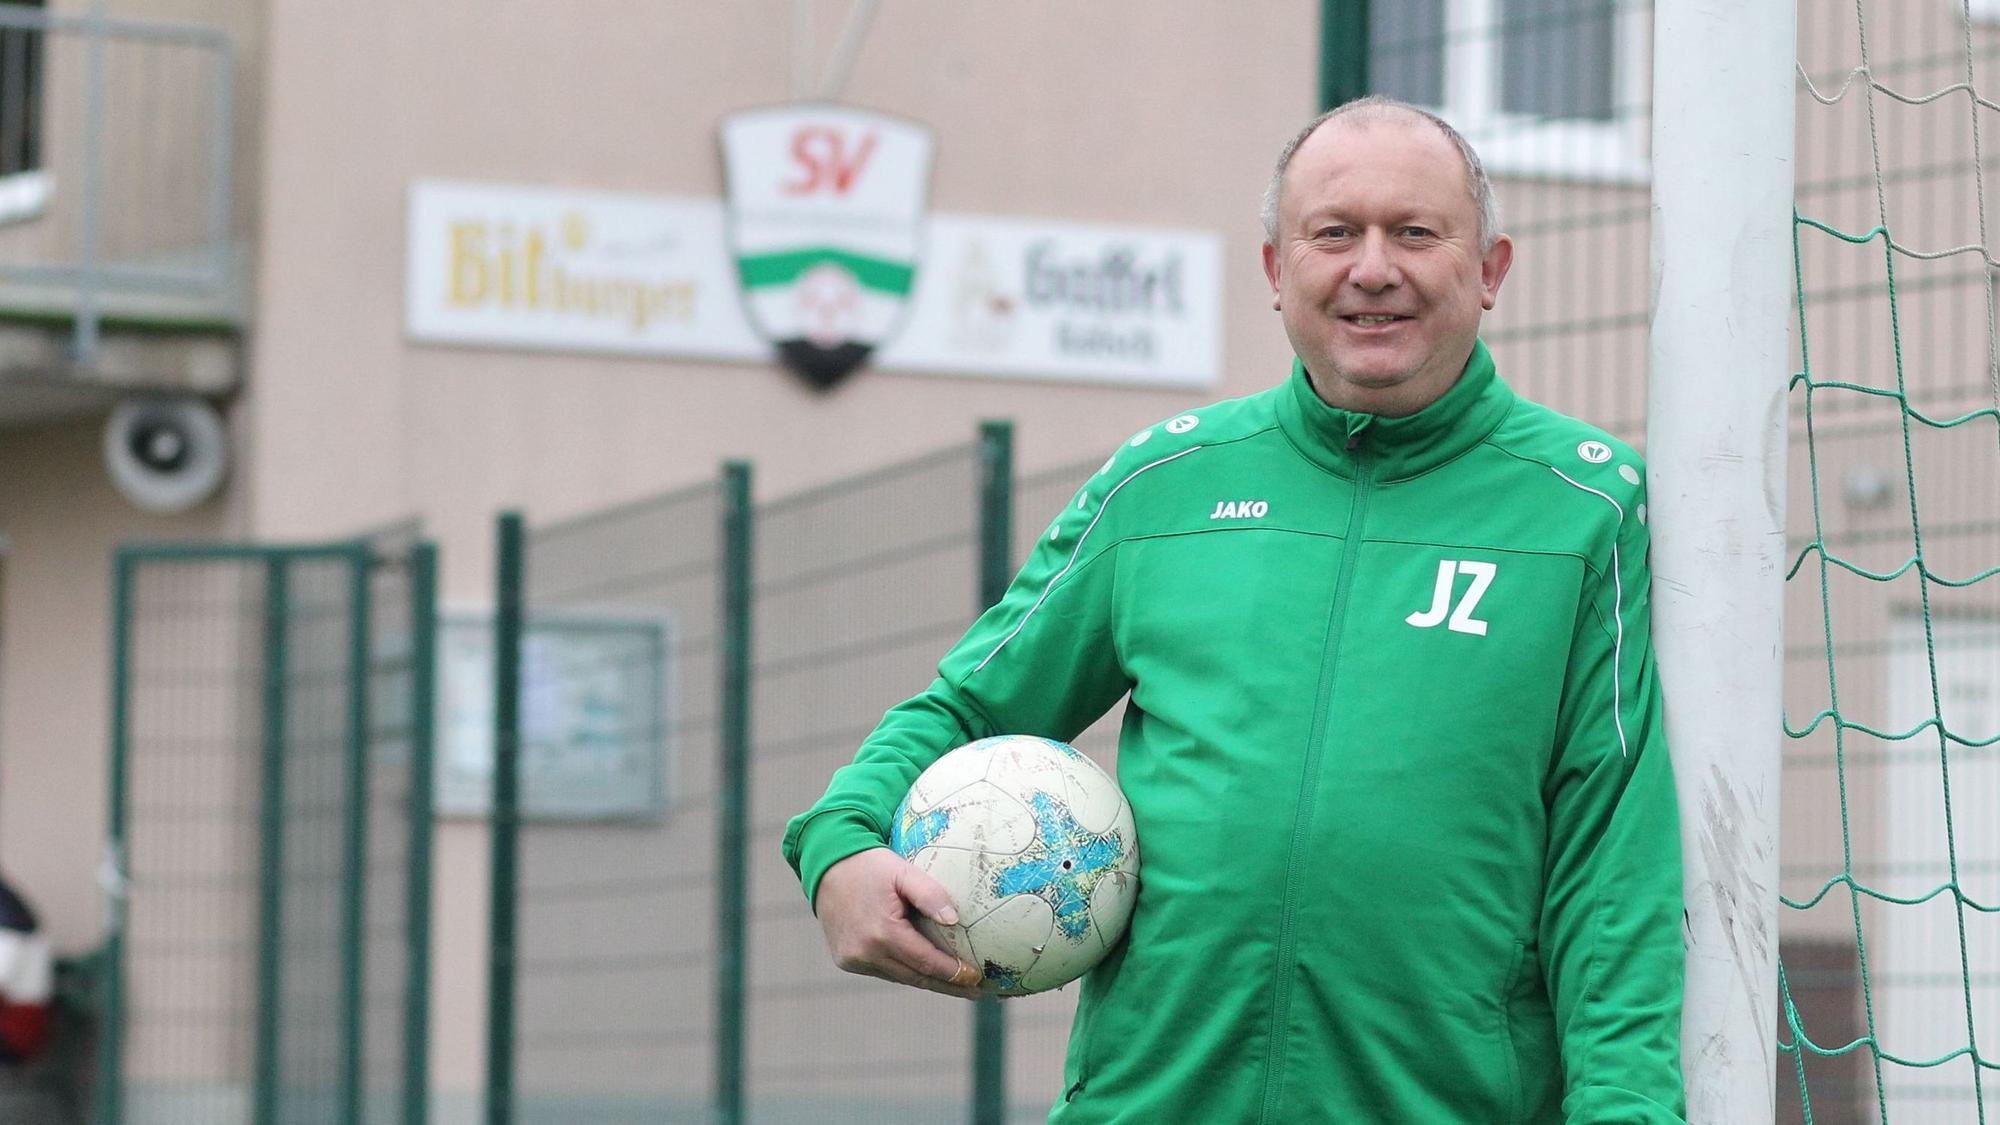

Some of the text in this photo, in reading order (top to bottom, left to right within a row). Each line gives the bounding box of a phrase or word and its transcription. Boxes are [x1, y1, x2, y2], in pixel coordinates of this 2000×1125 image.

[780, 126, 879, 196] SV
[1210, 500, 1268, 520] JAKO
[1405, 560, 1498, 636] JZ
